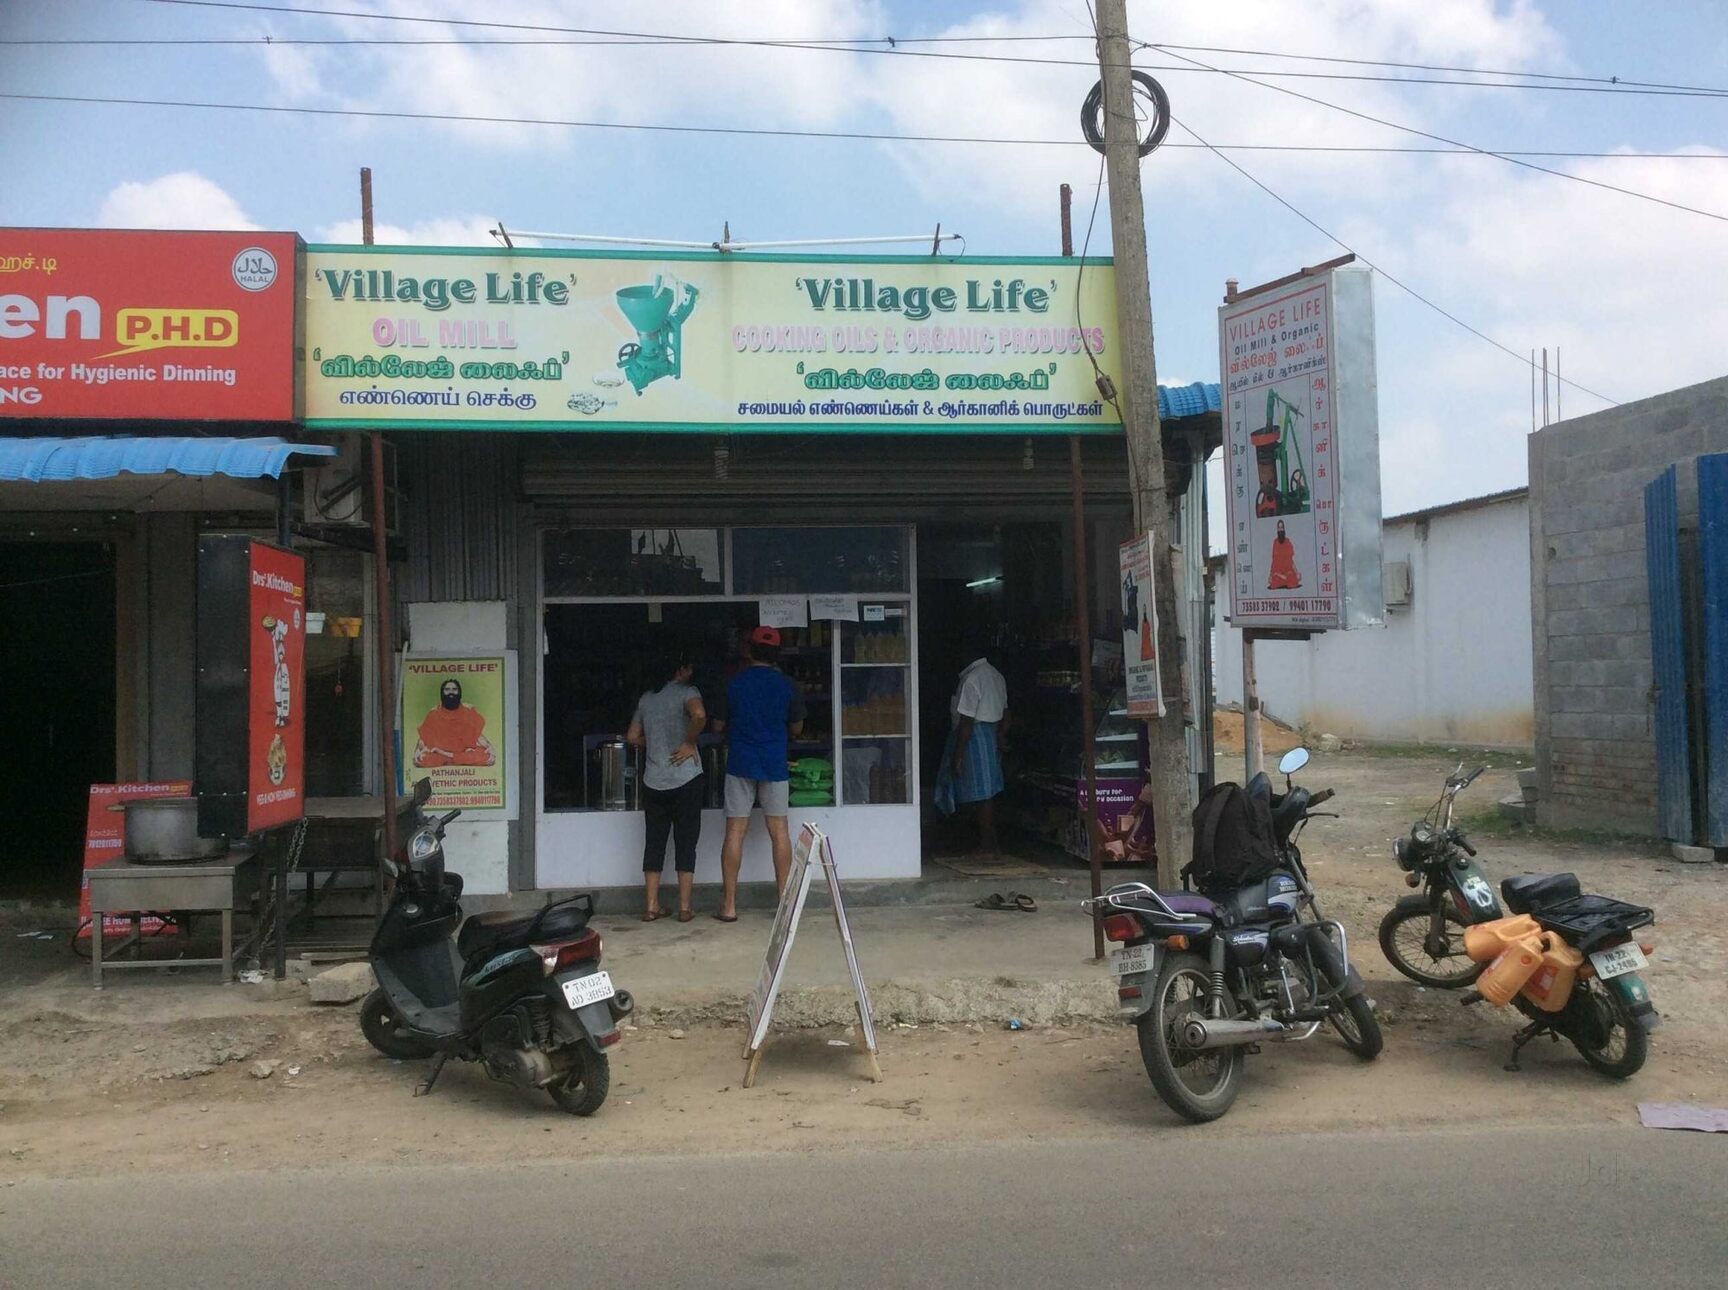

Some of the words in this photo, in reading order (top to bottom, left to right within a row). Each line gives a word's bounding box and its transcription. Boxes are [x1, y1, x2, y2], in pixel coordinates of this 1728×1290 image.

[238, 257, 273, 274] حلال
[126, 315, 233, 343] P.H.D
[1230, 310, 1286, 343] VILLAGE
[1293, 298, 1321, 322] LIFE
[372, 318, 429, 348] OIL
[439, 319, 518, 350] MILL
[732, 326, 826, 353] COOKING
[832, 326, 877, 353] OILS
[883, 327, 898, 353] &
[904, 326, 993, 354] ORGANIC
[999, 326, 1105, 355] PRODUCTS
[1234, 343, 1247, 355] Oil
[1250, 337, 1267, 351] Mill
[1270, 334, 1277, 345] &
[1281, 321, 1319, 342] Organic
[37, 363, 65, 380] for
[71, 363, 157, 385] Hygienic
[163, 364, 237, 387] Dinning
[339, 385, 461, 407] எண்ணெய்
[466, 386, 538, 411] செக்கு
[737, 399, 806, 418] சமையல்
[809, 399, 919, 418] எண்ணெய்கள்
[923, 402, 935, 417] &
[938, 399, 1020, 420] ஆர்கானிக்
[1023, 399, 1104, 419] பொருட்கள்
[431, 768, 476, 777] PATHANJALI
[458, 779, 497, 788] PRODUCTS
[573, 982, 588, 993] TN
